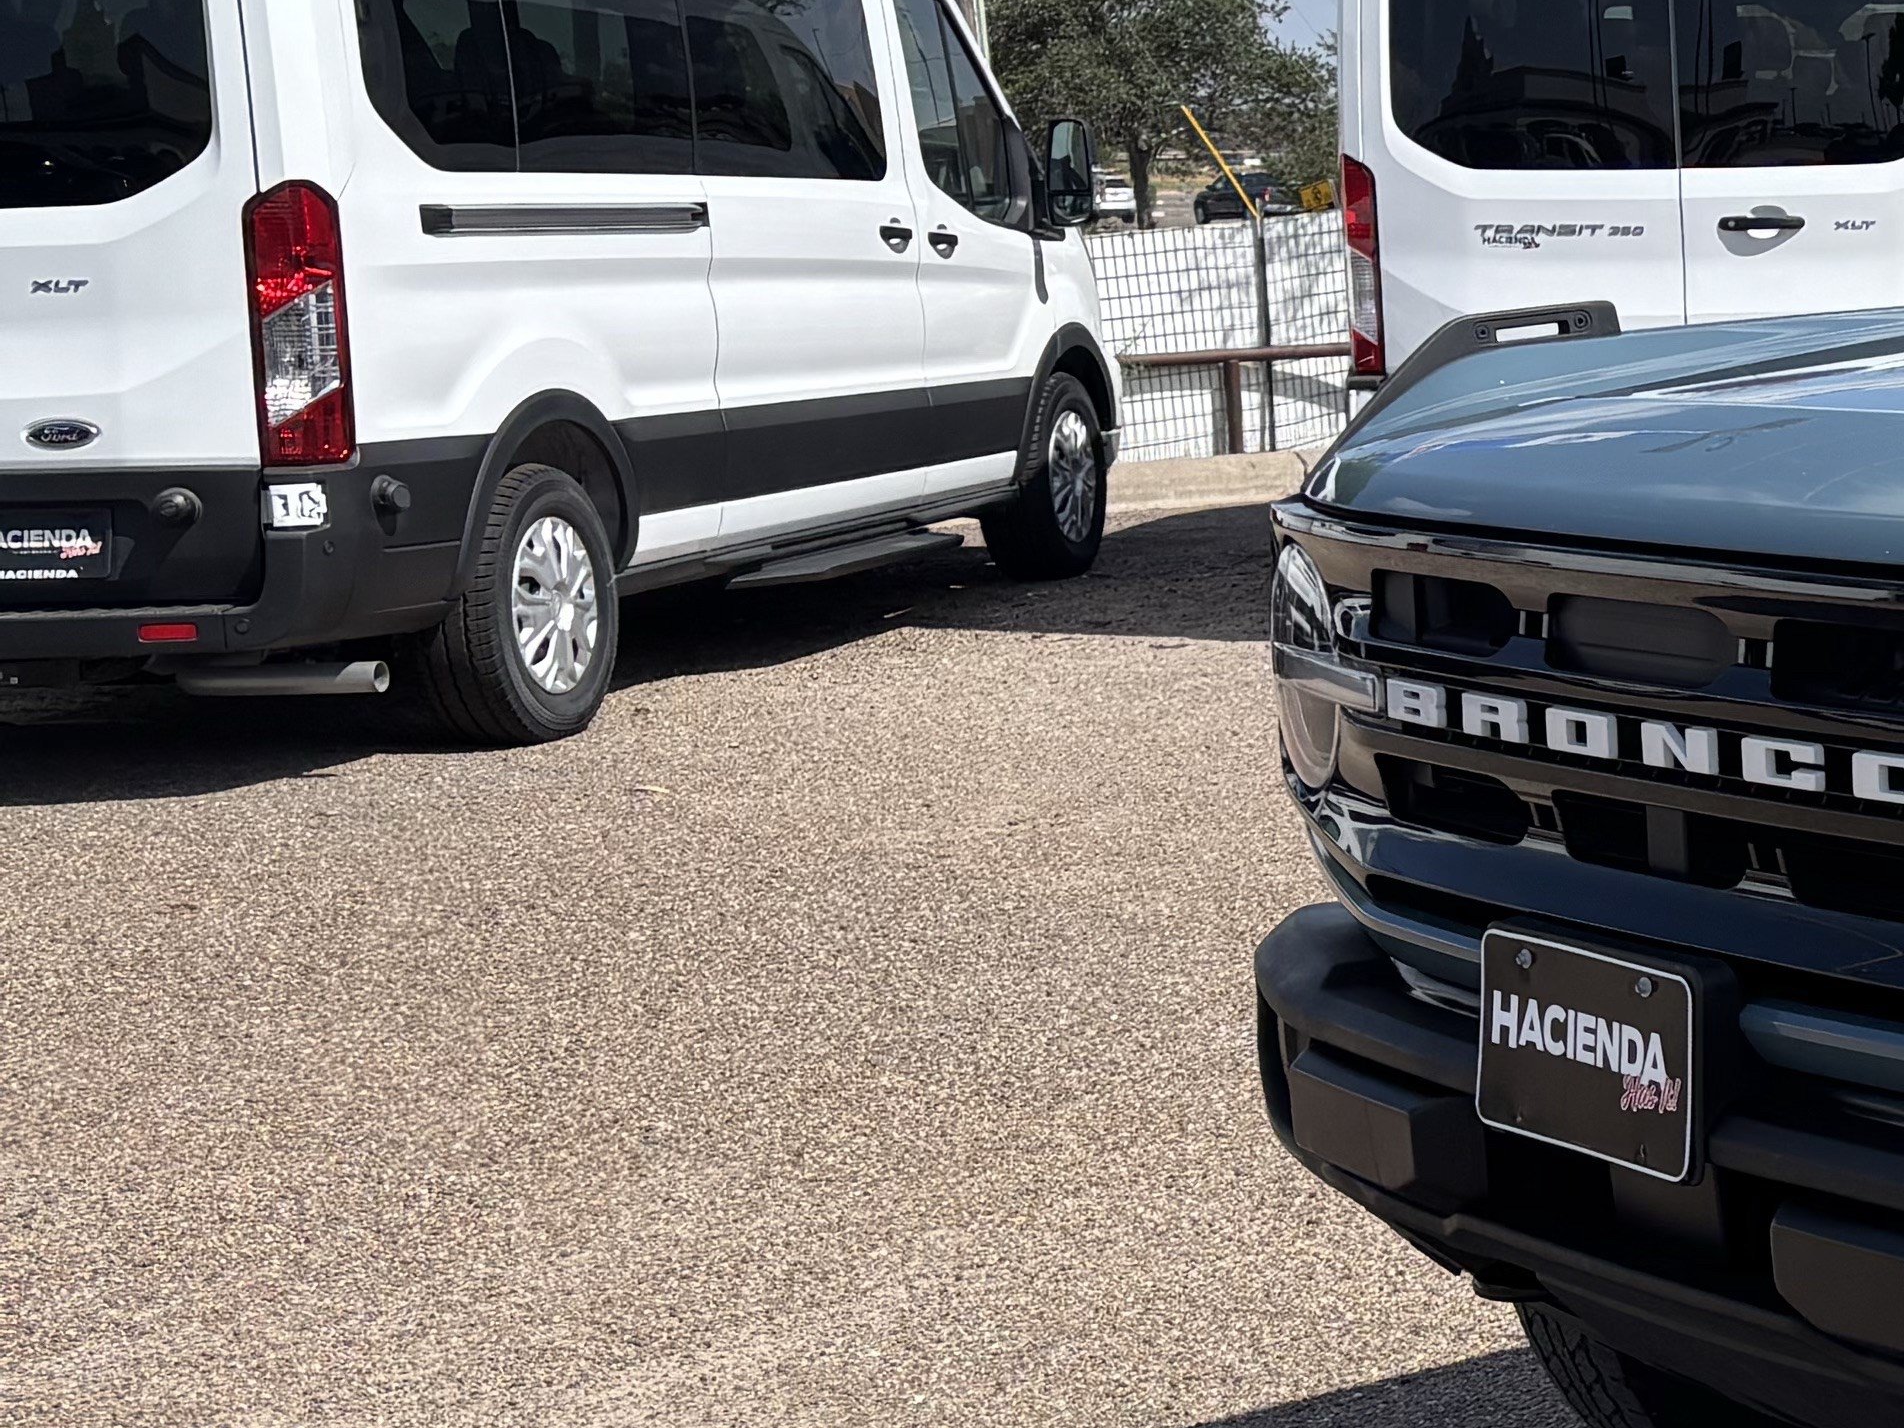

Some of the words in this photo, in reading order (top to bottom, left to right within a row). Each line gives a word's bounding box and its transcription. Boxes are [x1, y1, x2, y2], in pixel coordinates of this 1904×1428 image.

[1474, 224, 1604, 239] TRANSIT
[1833, 220, 1876, 231] XLT
[29, 279, 89, 294] XLT
[41, 426, 80, 442] Ford
[1491, 989, 1669, 1090] HACIENDA
[1620, 1074, 1659, 1112] Has
